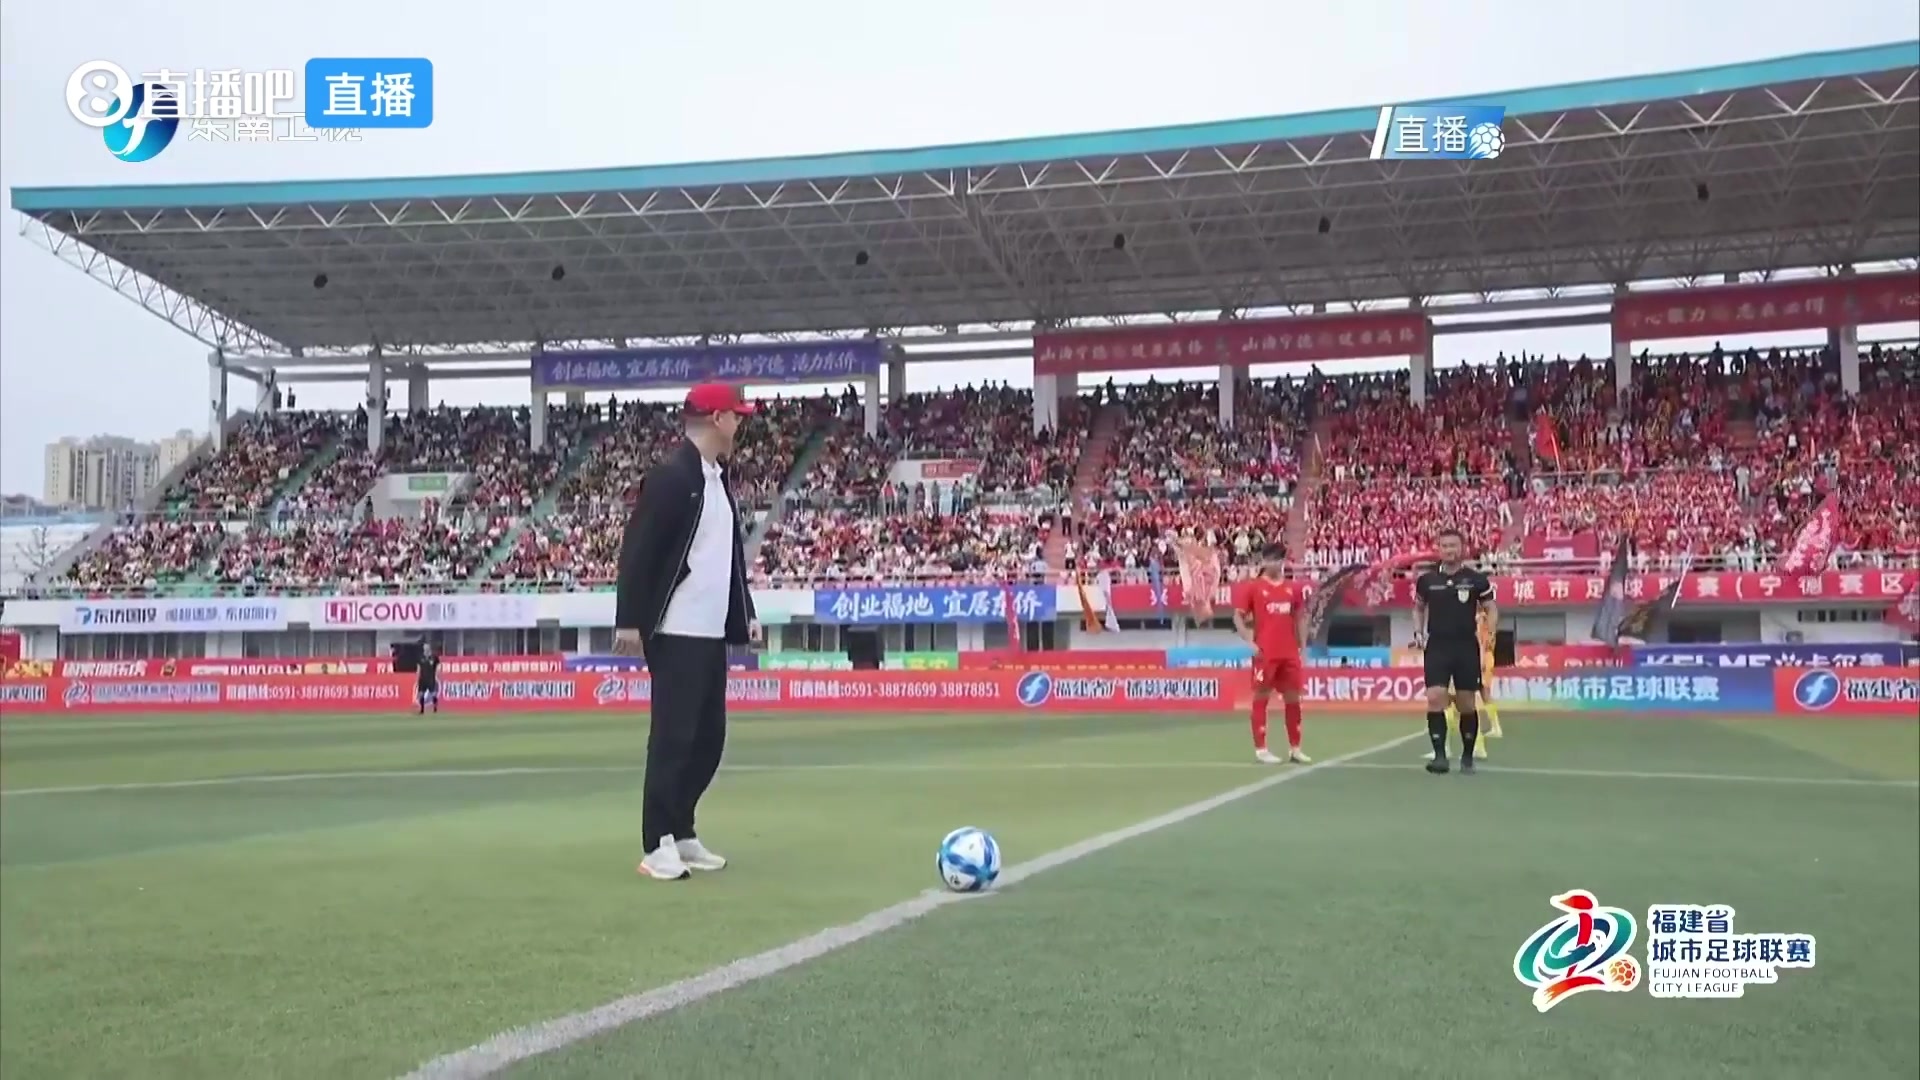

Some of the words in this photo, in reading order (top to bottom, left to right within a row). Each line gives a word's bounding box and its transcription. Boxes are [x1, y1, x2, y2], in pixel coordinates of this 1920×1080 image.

[831, 590, 934, 622] 创业福地
[942, 589, 1043, 621] 宜居东侨
